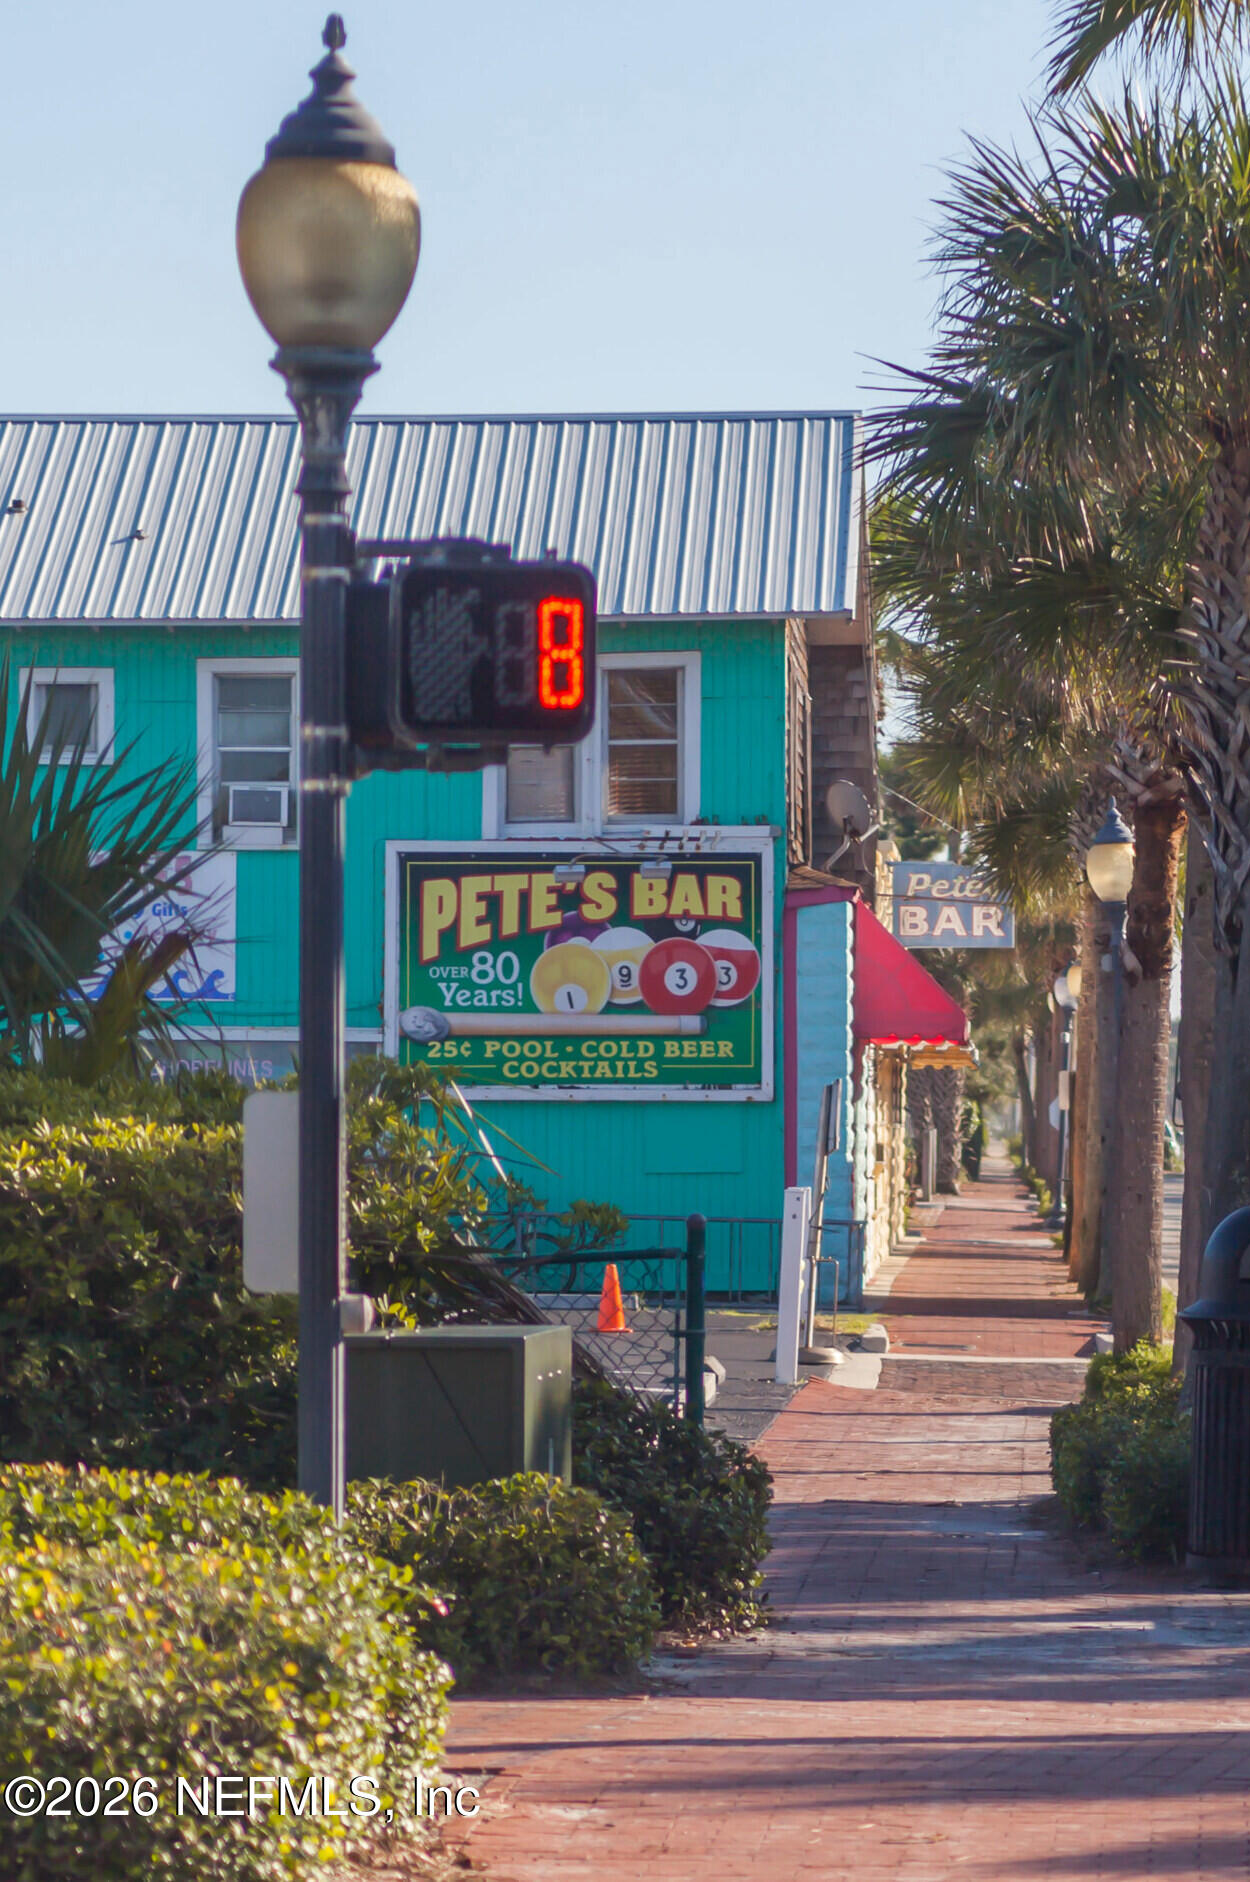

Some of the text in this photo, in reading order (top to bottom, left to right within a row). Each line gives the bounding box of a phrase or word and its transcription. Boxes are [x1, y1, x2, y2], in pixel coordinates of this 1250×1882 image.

[538, 597, 584, 709] 8
[420, 871, 743, 965] PETE'S BAR
[899, 904, 1006, 937] BAR
[429, 951, 520, 984] OVER 80
[618, 965, 632, 983] 9
[675, 968, 688, 989] 3
[437, 982, 523, 1006] Years!
[427, 1040, 734, 1058] 25¢ POOL COLD BEER
[502, 1060, 658, 1079] COCKTAILS
